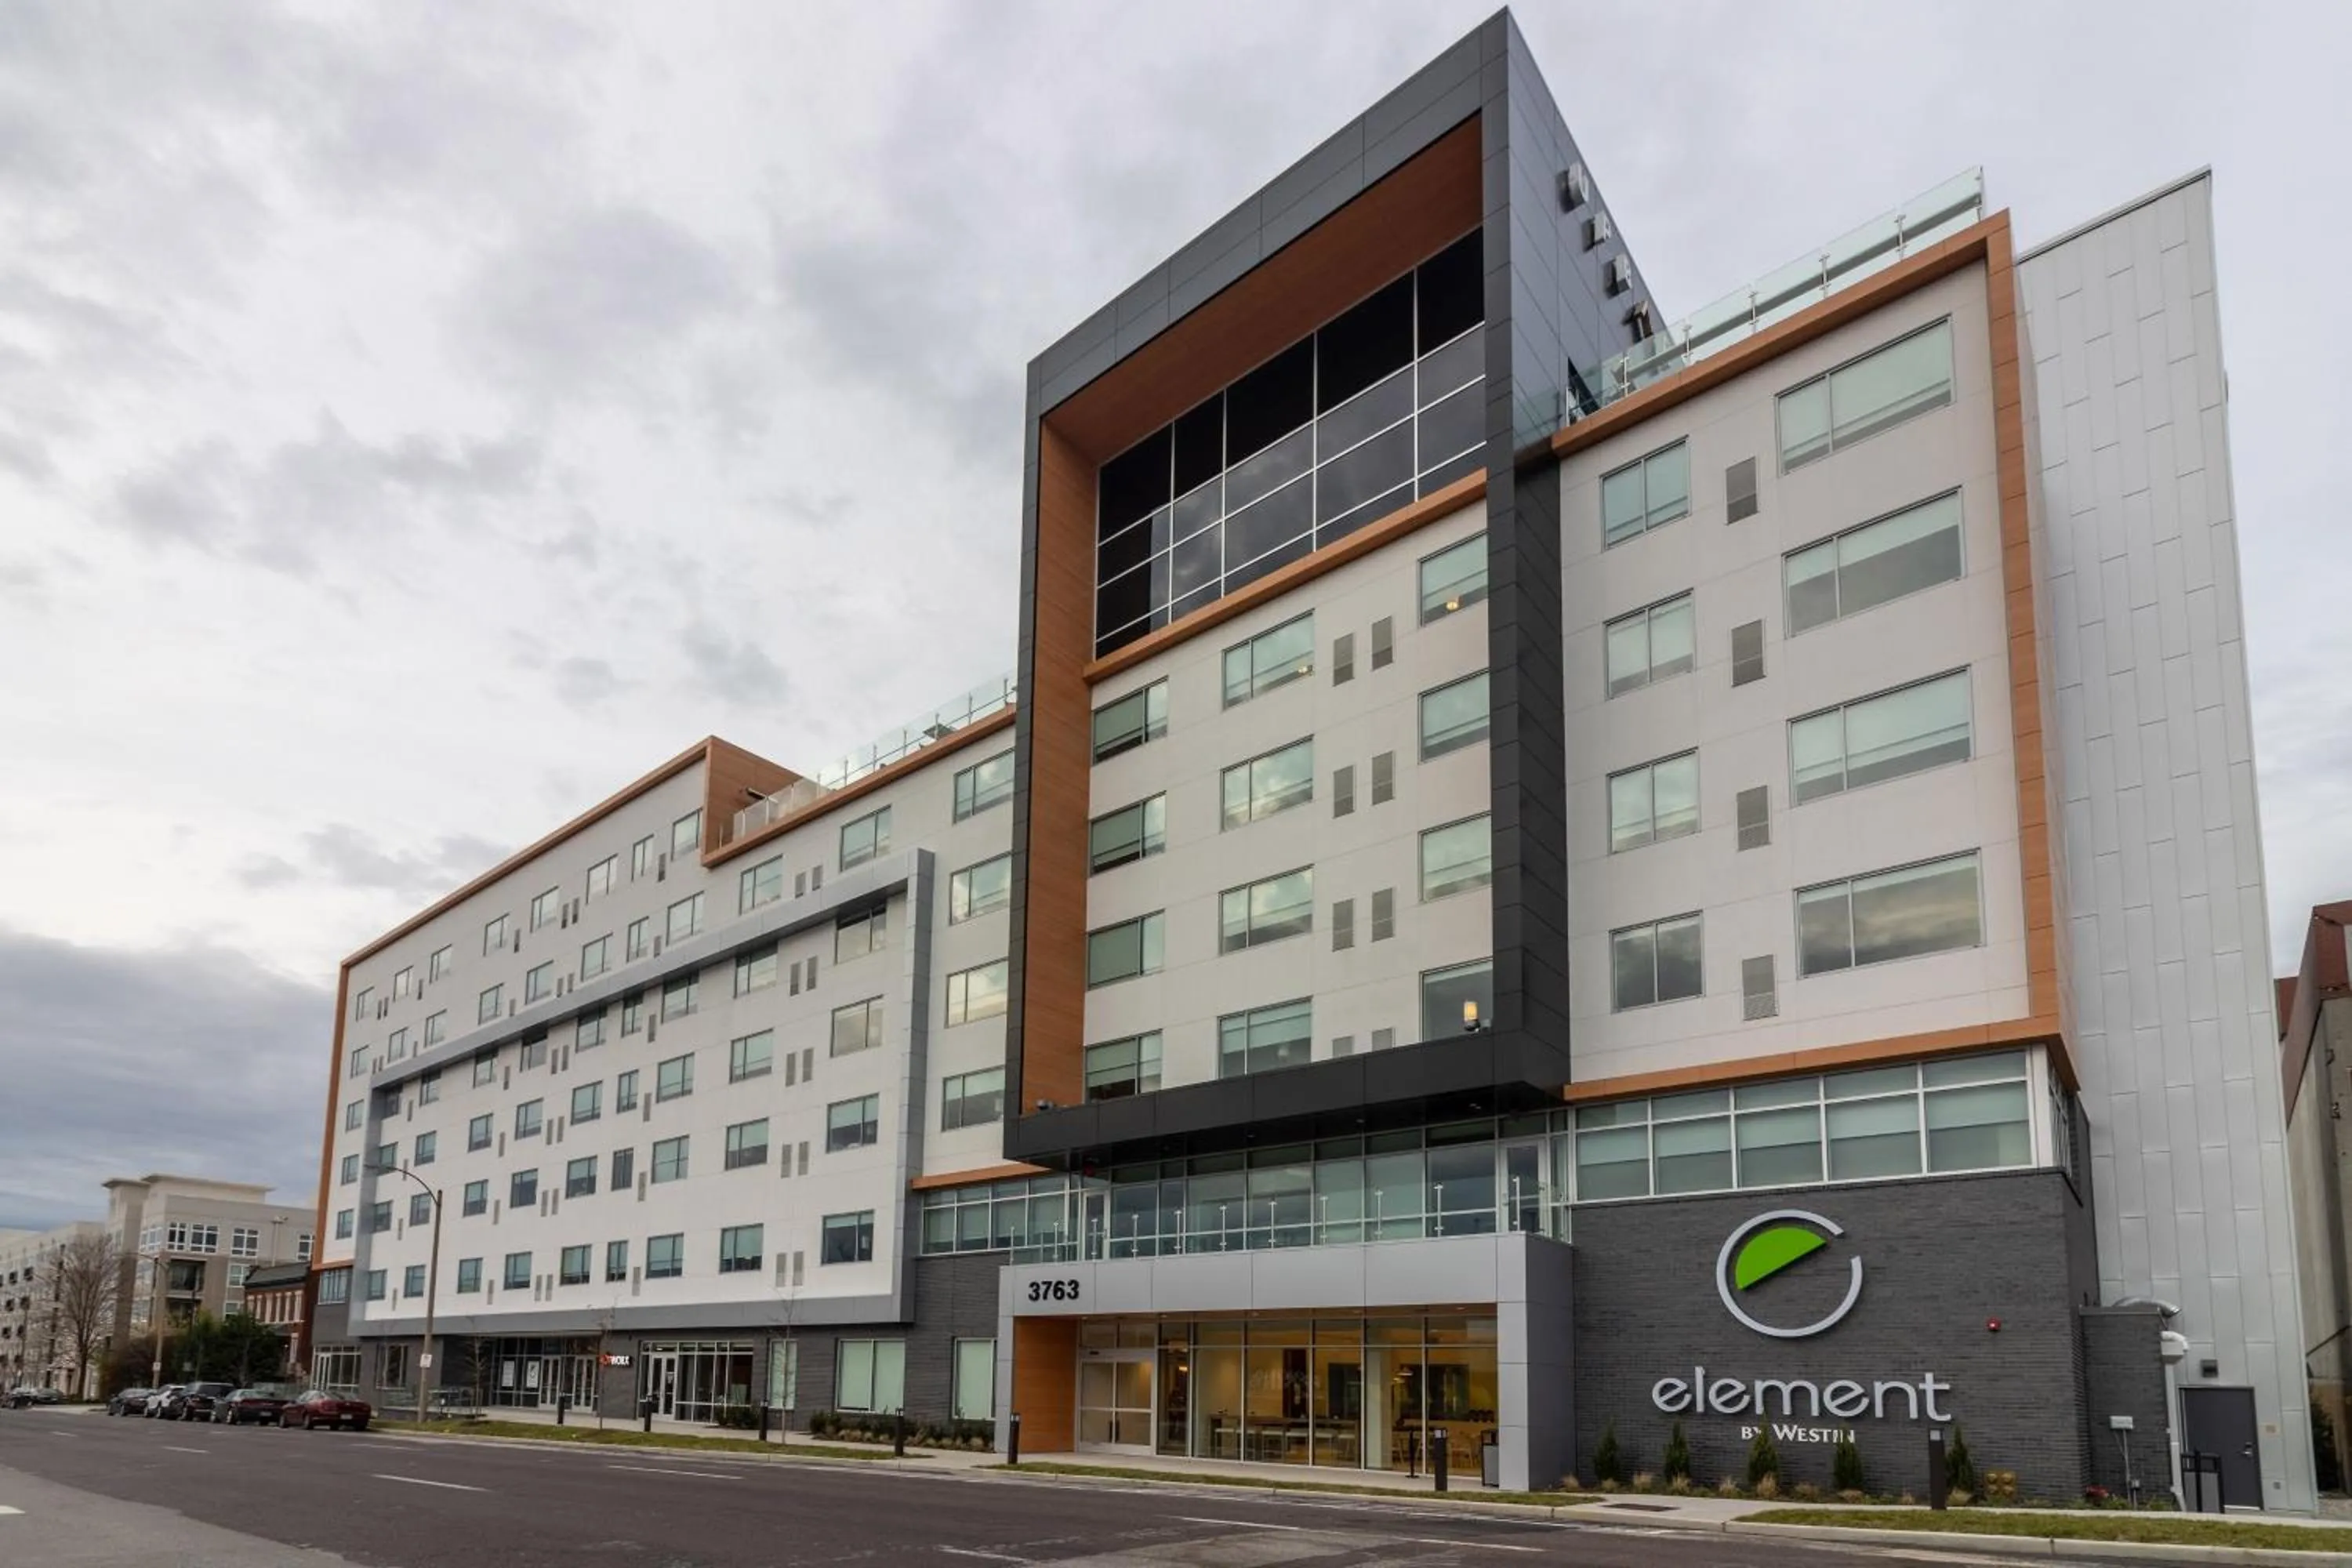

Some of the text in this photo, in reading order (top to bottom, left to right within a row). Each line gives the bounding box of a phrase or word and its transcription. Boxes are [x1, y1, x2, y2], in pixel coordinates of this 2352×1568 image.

[1028, 1279, 1080, 1302] 3763
[1651, 1367, 1952, 1421] element
[1772, 1423, 1856, 1444] WESTIN
